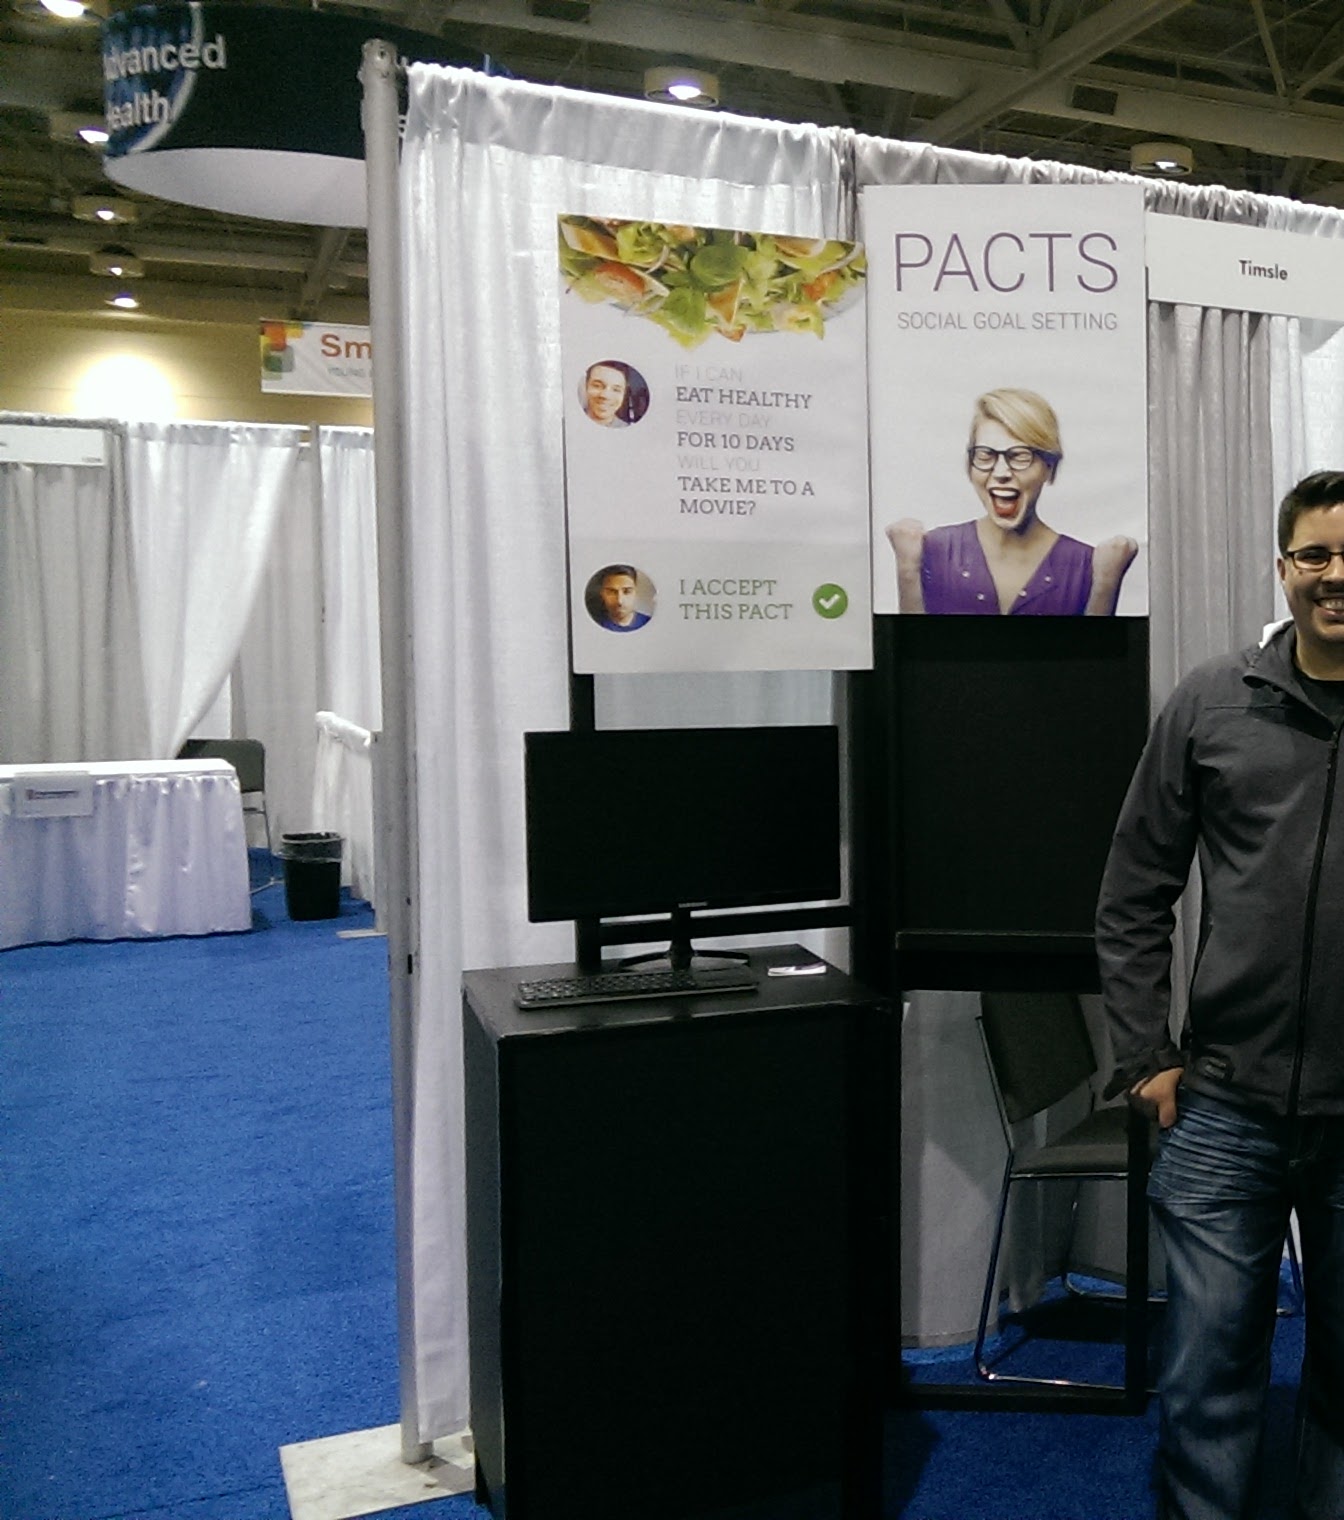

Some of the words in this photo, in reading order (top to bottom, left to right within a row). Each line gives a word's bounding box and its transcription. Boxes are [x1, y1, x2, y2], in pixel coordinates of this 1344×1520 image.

[103, 34, 227, 80] dvanced
[895, 232, 1119, 293] PACTS
[1239, 259, 1288, 280] Timsle
[897, 311, 967, 330] SOCIAL
[973, 311, 1027, 330] GOAL
[1031, 312, 1118, 330] SETTING
[675, 364, 689, 380] IF
[705, 366, 743, 382] CAN
[676, 386, 714, 403] EAT
[718, 388, 812, 409] HEALTHY
[676, 409, 733, 427] EVERY
[738, 412, 772, 429] DAY
[677, 431, 716, 448] FOR
[721, 433, 741, 449] 10
[746, 434, 795, 452] DAYS
[677, 455, 720, 471] WILL
[725, 456, 760, 472] YOU
[677, 476, 731, 493] TAKE
[735, 478, 767, 494] ME
[770, 479, 797, 495] TO
[801, 481, 815, 496] A
[680, 498, 756, 515] MOVIE?
[679, 579, 685, 595] I
[691, 579, 777, 595] ACCEPT
[679, 603, 733, 620] THIS
[738, 603, 793, 620] PACT
